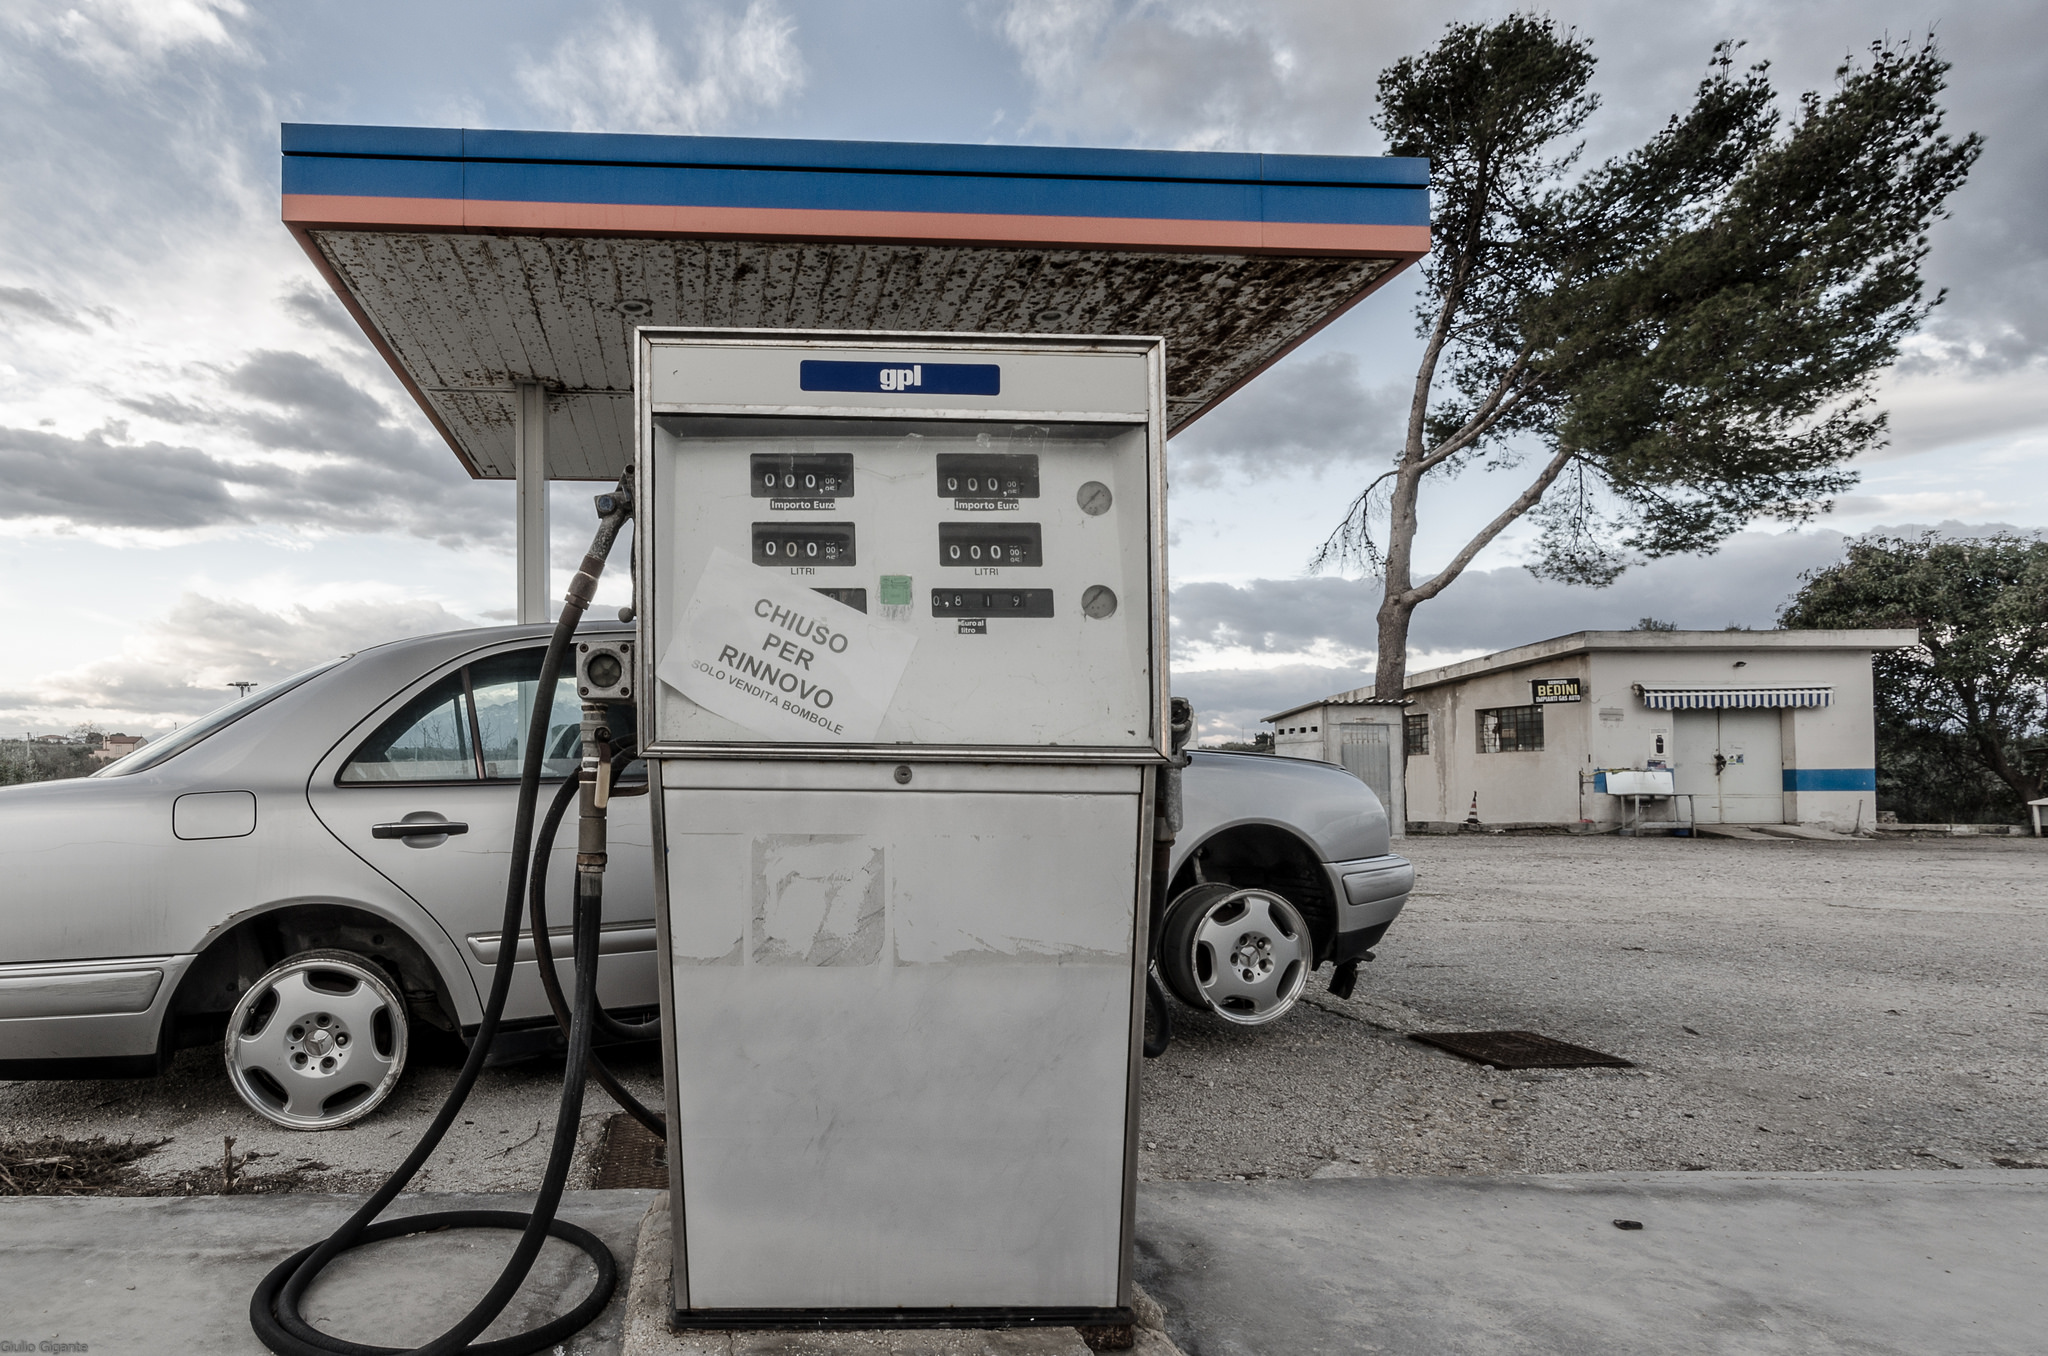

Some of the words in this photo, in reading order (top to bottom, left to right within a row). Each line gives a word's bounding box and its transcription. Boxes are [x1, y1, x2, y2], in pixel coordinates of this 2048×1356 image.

[880, 364, 922, 391] gpl
[771, 500, 811, 511] Importo
[813, 500, 836, 509] Euro
[955, 500, 995, 511] Importo
[997, 501, 1020, 510] Euro
[790, 567, 816, 575] LITRI
[974, 567, 999, 576] LITRI
[754, 598, 849, 654] CHIUSO
[761, 632, 815, 671] PER
[718, 644, 834, 709] RINNOVO
[691, 659, 726, 681] SOLO
[728, 674, 779, 706] VENDITA
[781, 700, 844, 735] BOMBOLE
[1538, 684, 1578, 696] BEDINI
